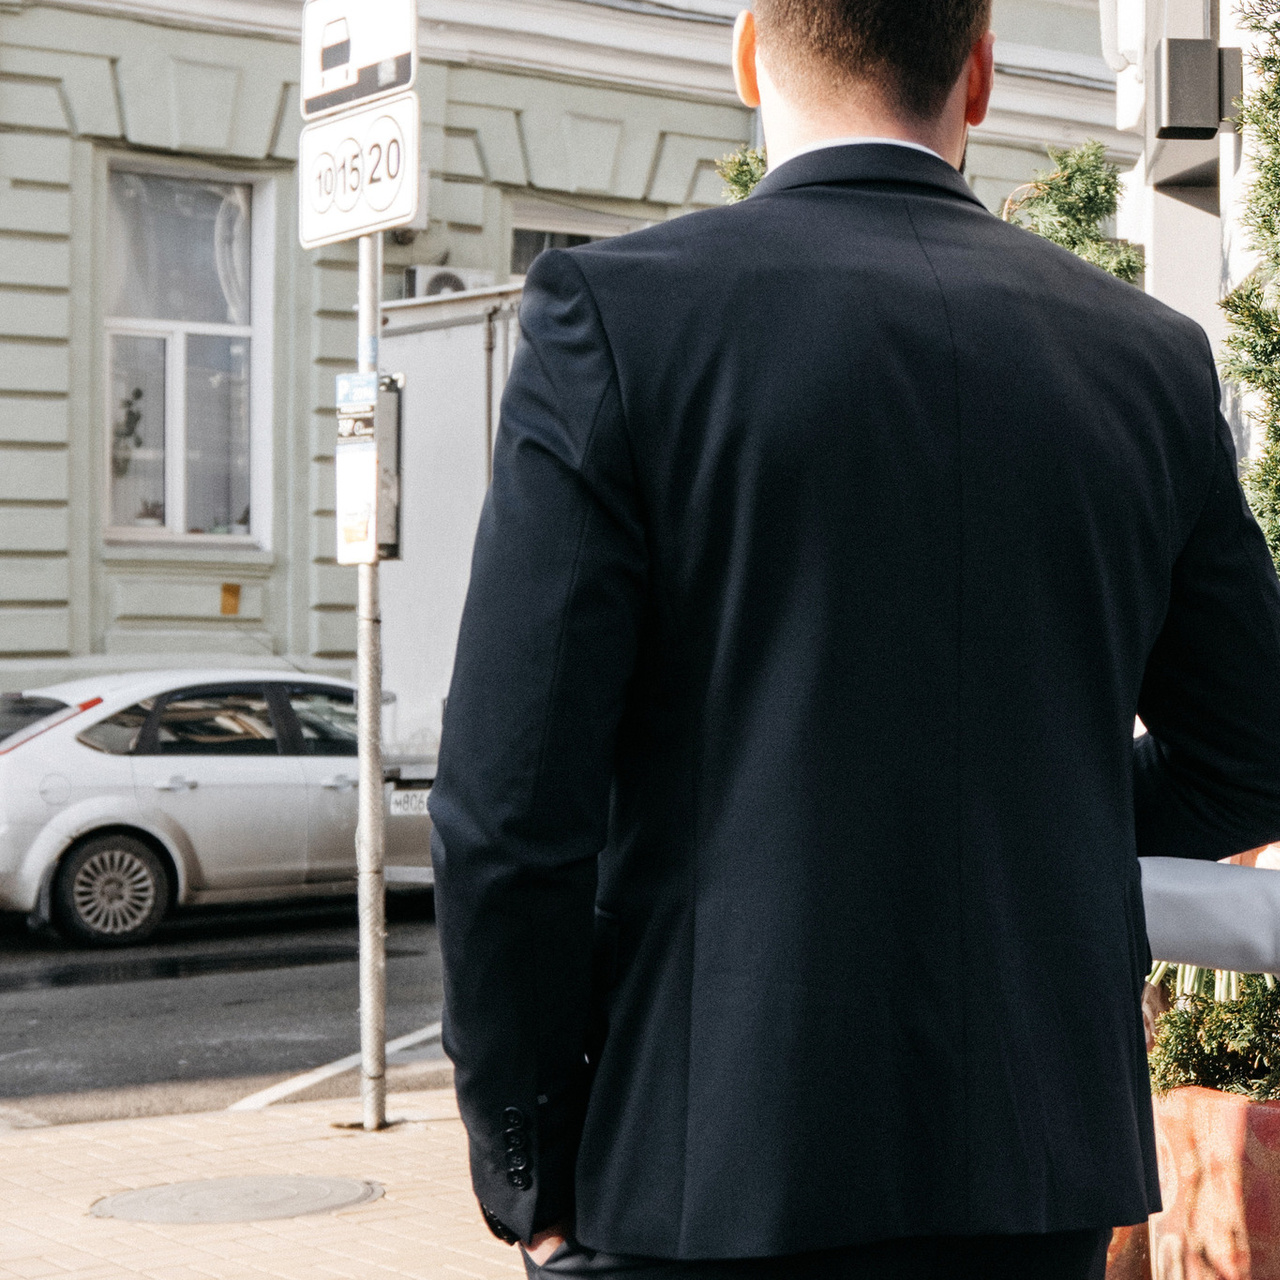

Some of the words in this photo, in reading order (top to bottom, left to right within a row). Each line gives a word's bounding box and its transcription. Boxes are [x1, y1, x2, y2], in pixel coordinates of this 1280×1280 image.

[316, 168, 334, 197] 10
[338, 153, 361, 195] 15
[368, 138, 401, 185] 20
